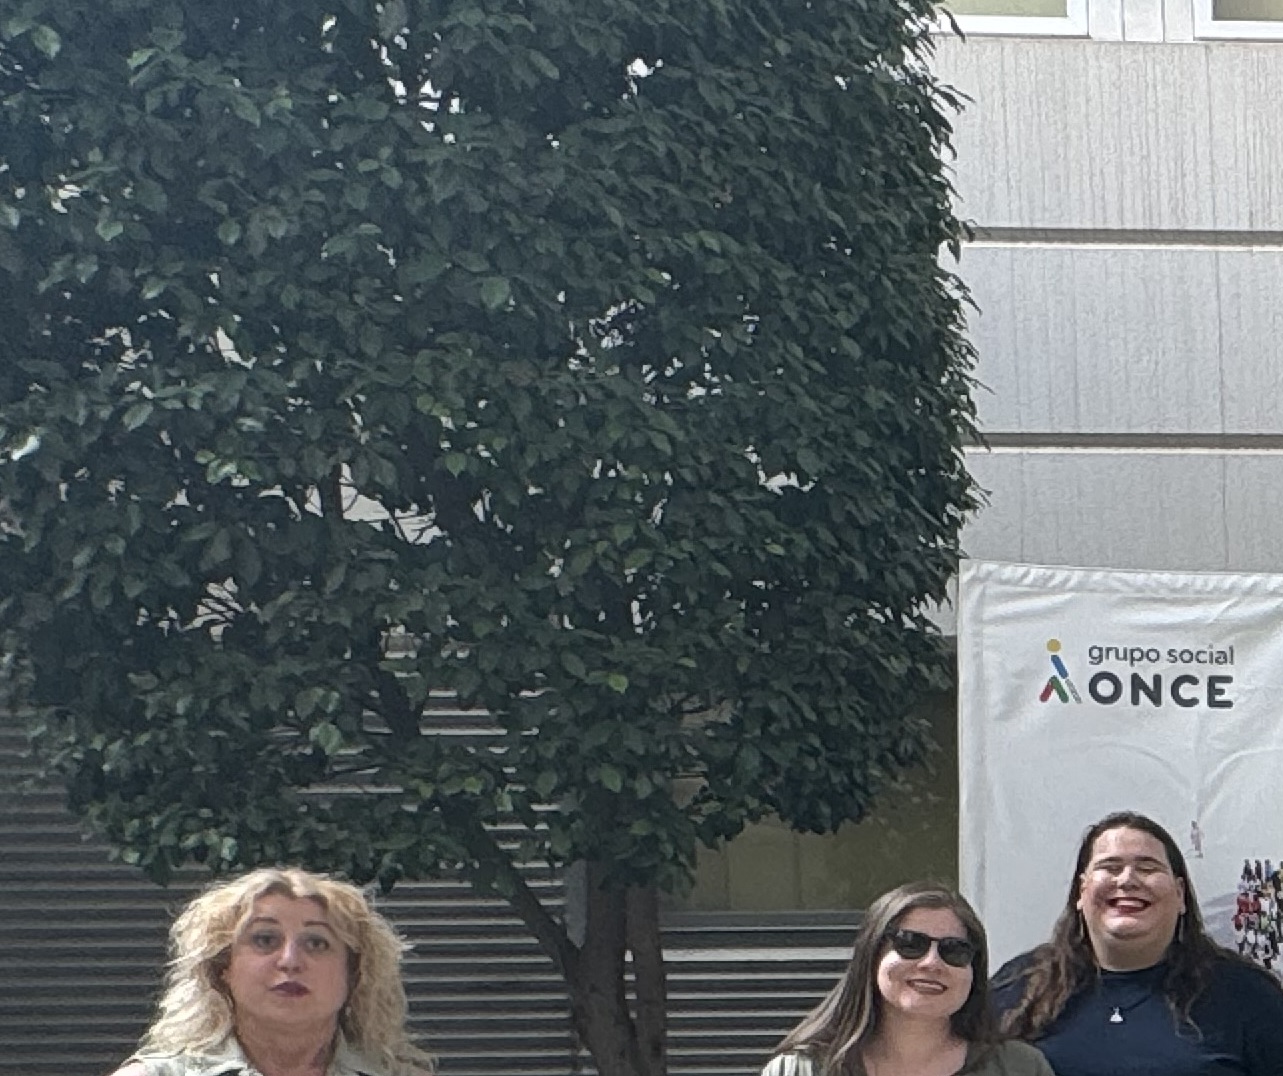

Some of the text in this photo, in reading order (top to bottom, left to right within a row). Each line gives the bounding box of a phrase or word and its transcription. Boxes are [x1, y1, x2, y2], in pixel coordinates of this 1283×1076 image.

[1088, 644, 1234, 667] grupo social
[1088, 671, 1234, 708] ONCE
